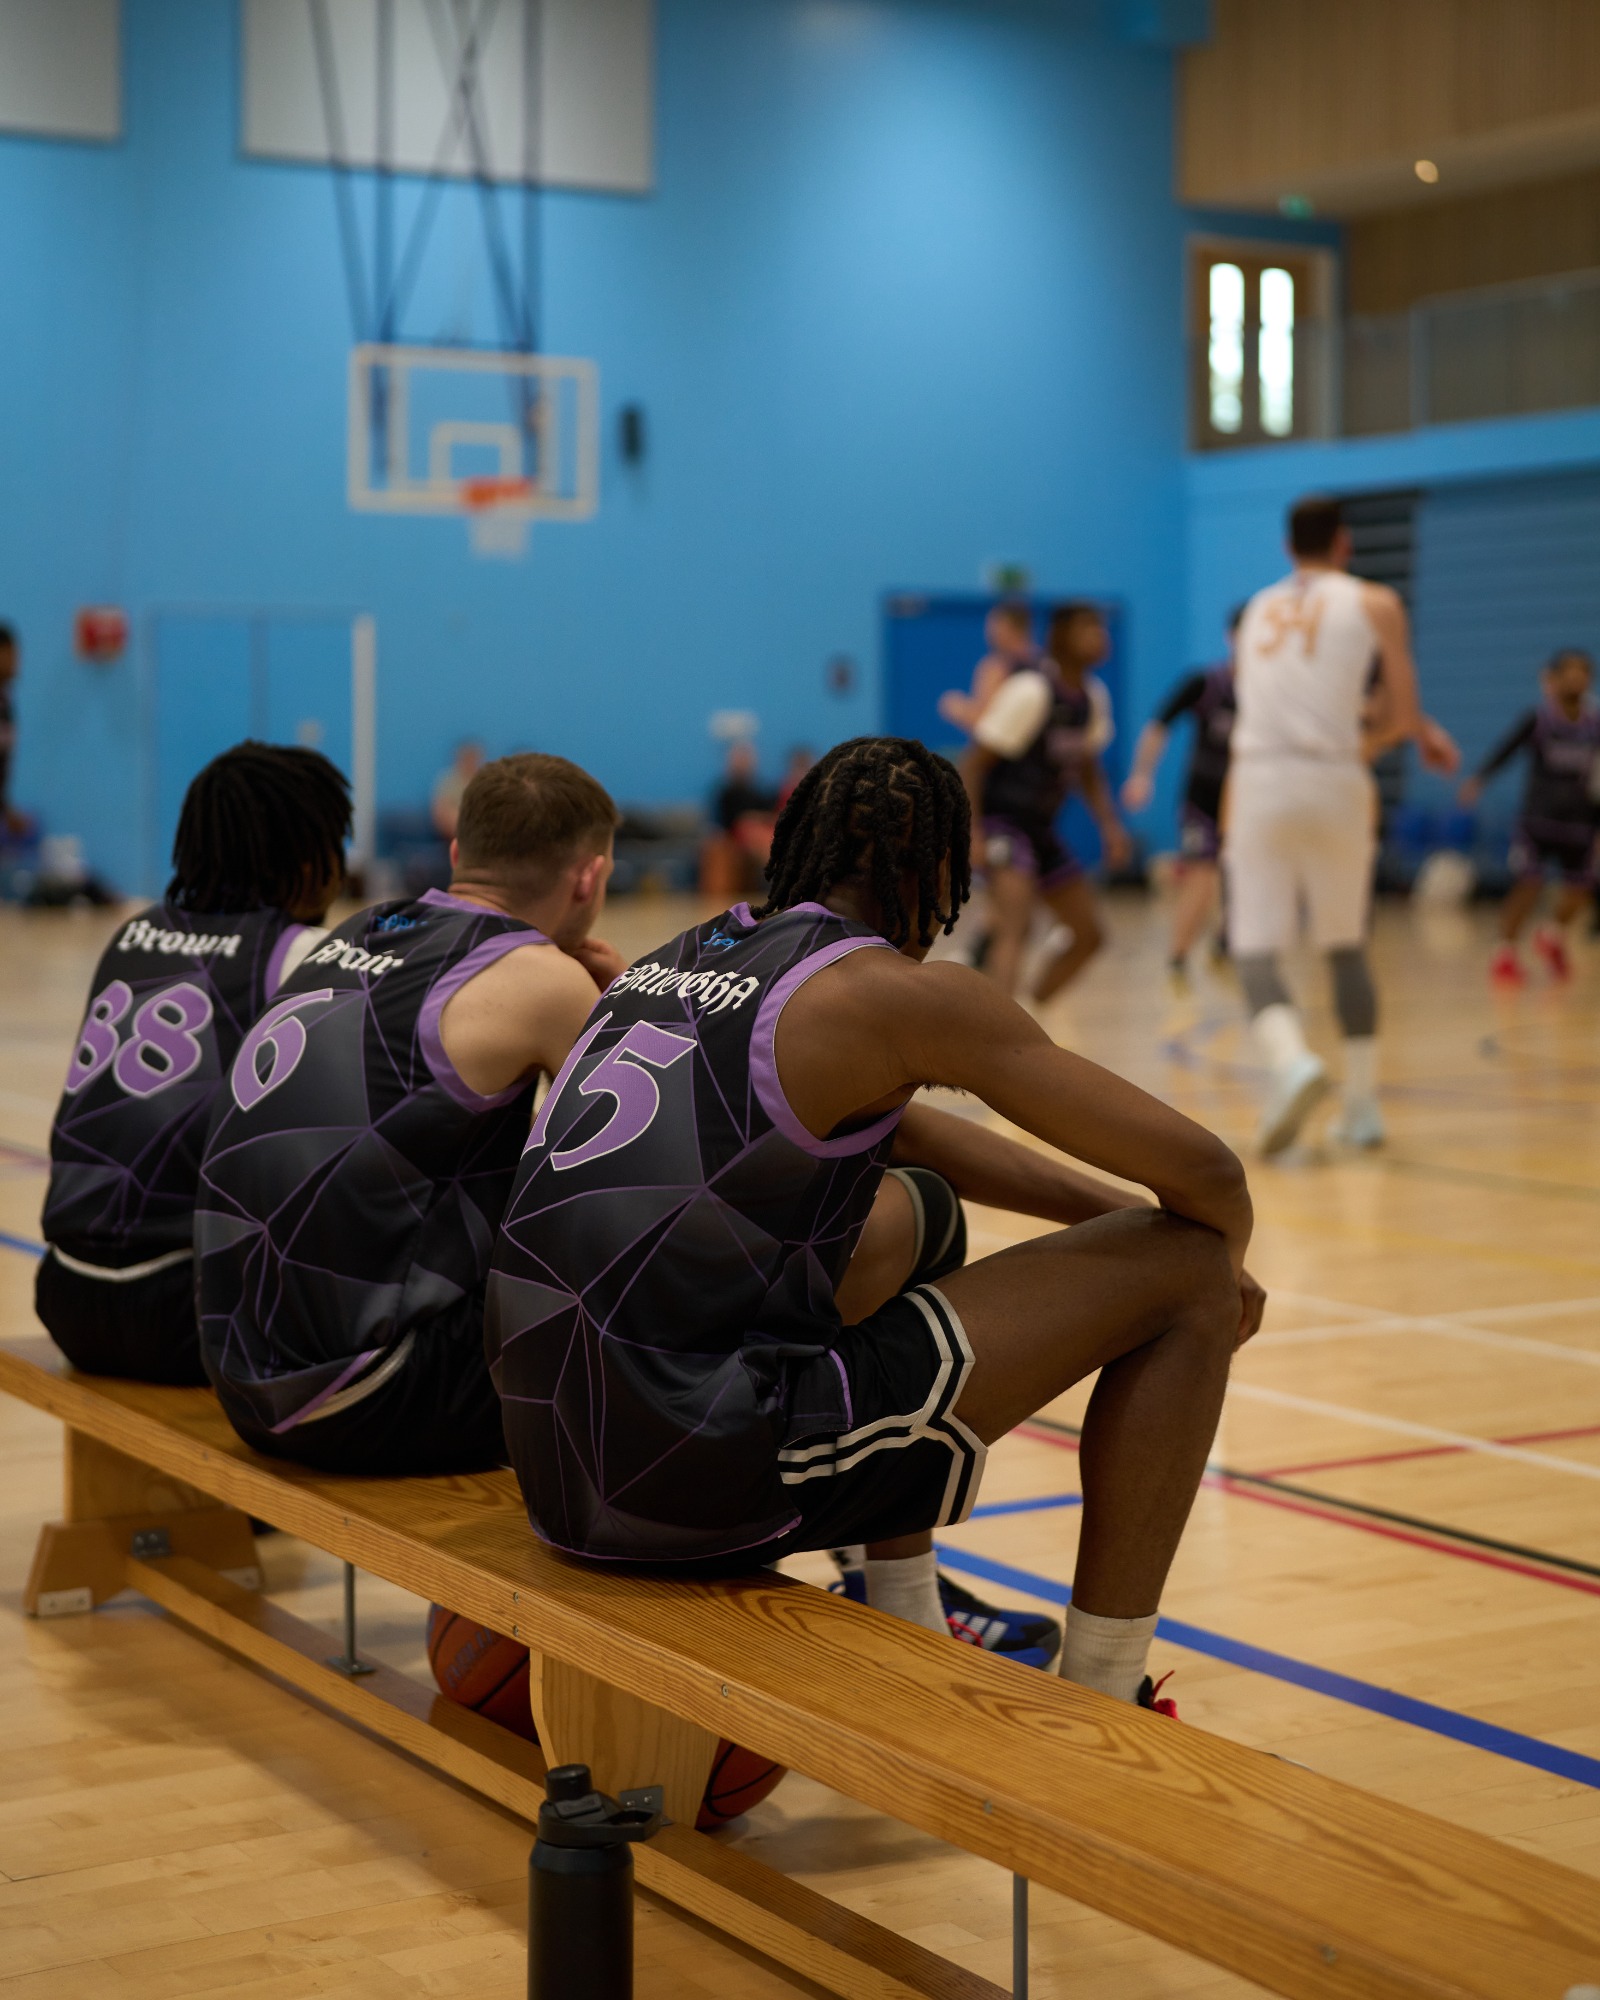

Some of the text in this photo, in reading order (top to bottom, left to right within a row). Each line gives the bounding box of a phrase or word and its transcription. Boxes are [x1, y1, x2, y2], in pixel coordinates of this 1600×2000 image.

[118, 919, 242, 957] Brown
[231, 988, 334, 1112] 6
[520, 1010, 698, 1172] 15
